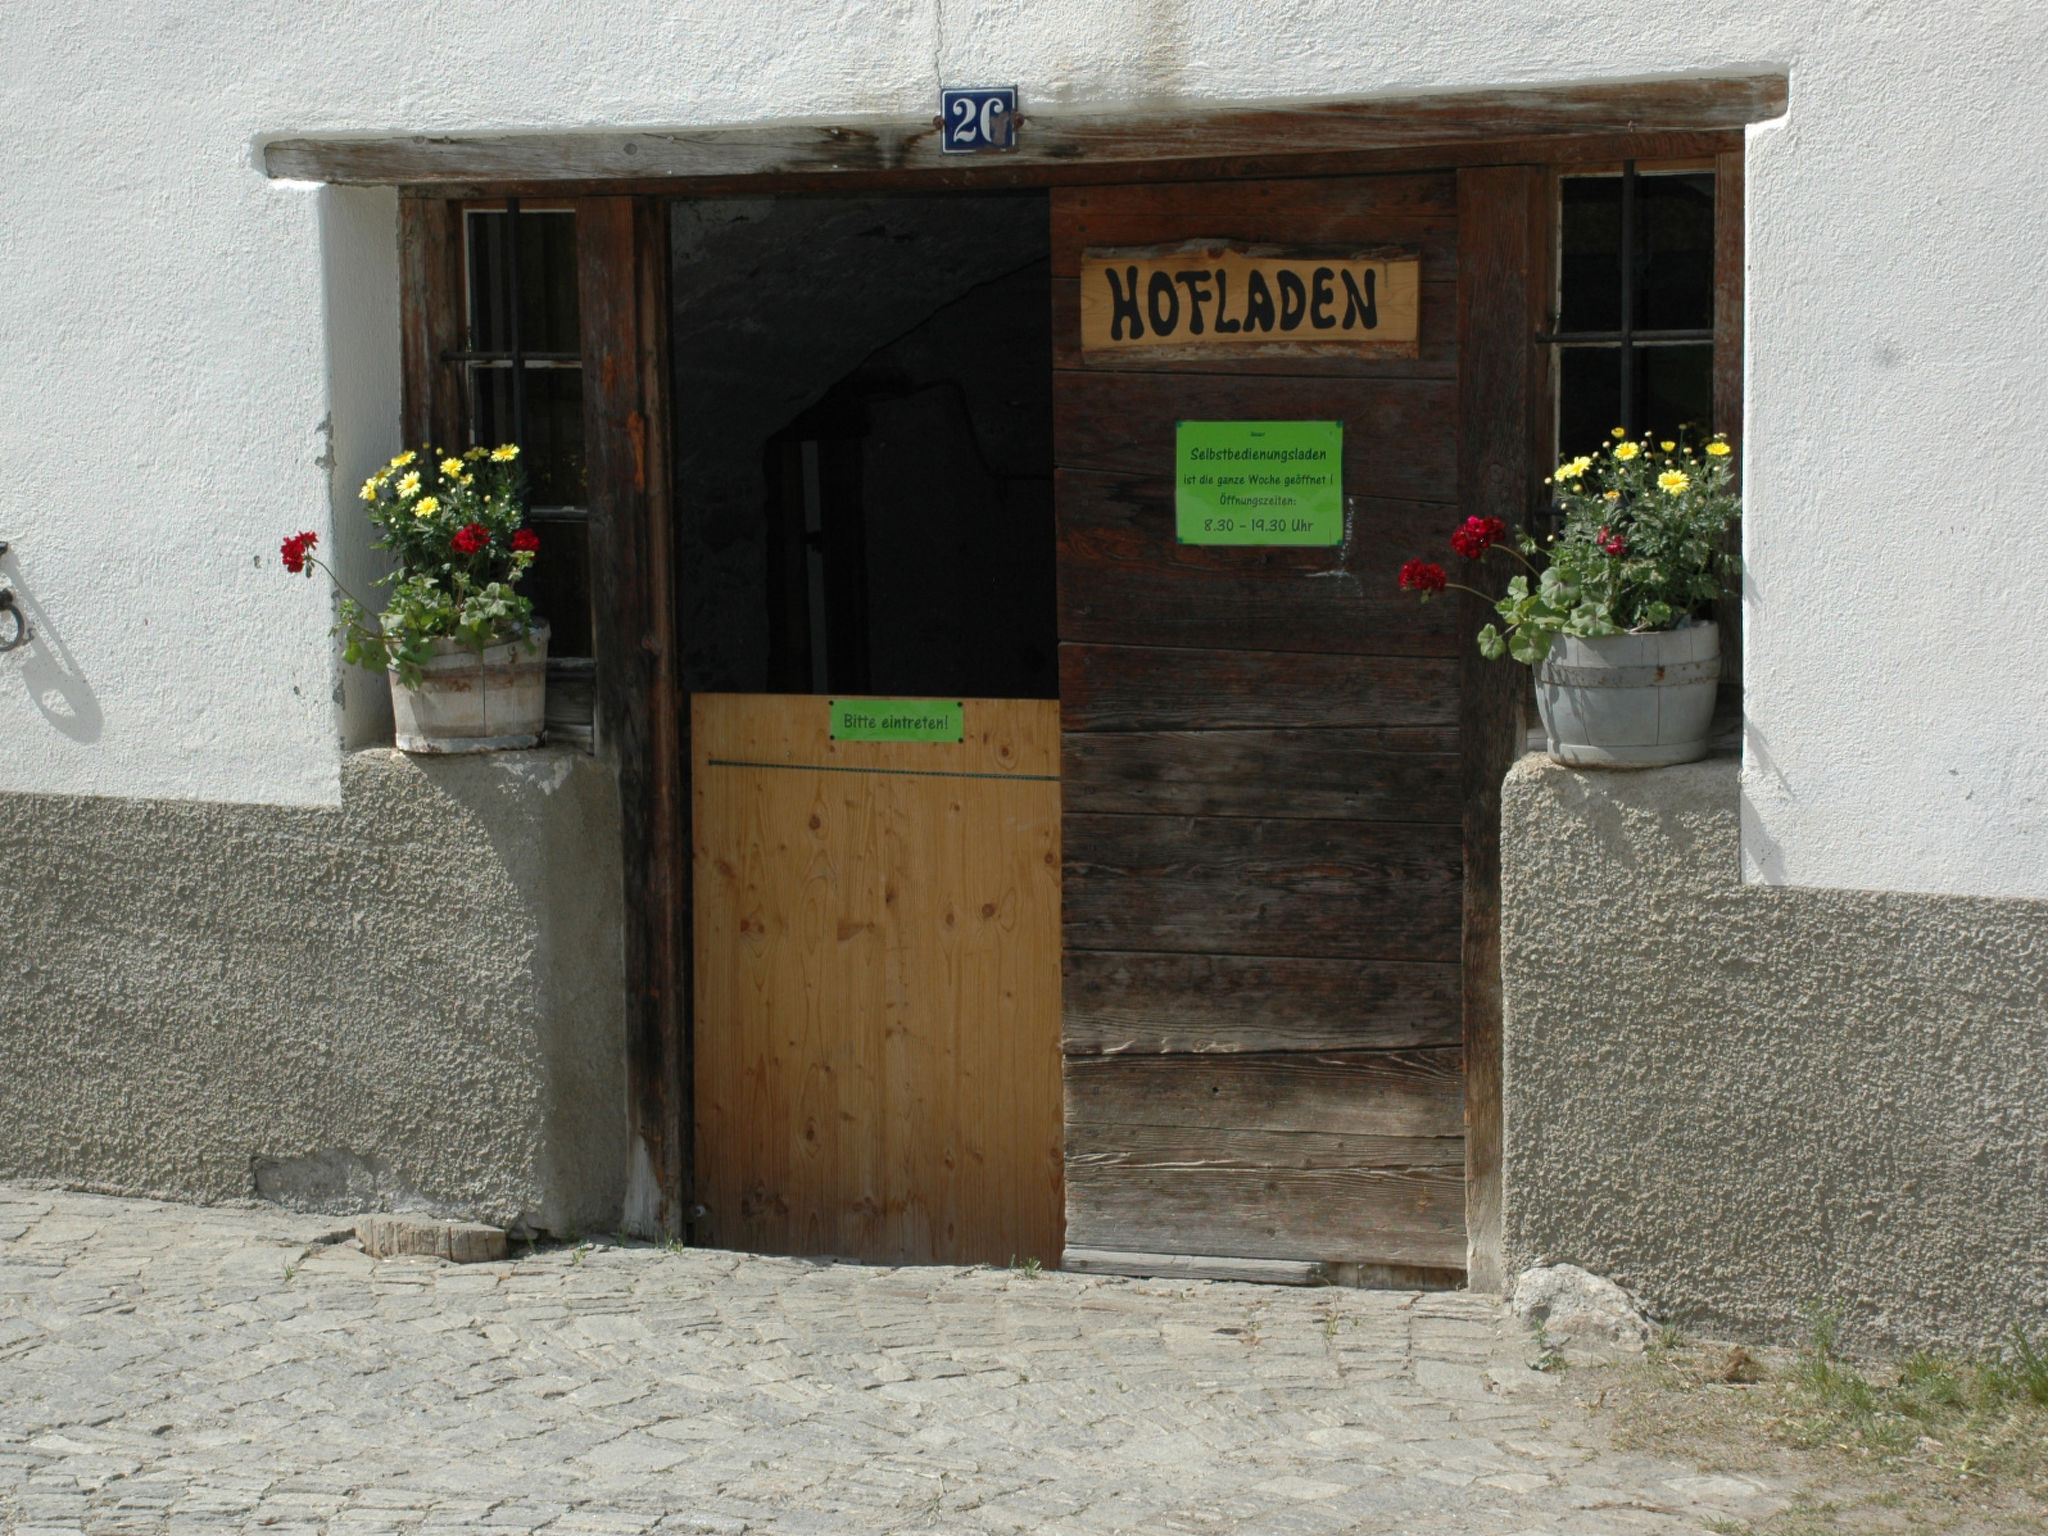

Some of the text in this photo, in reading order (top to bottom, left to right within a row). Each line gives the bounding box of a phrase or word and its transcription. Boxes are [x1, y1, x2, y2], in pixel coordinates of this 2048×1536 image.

[1106, 265, 1378, 341] HOFLADEN
[1190, 447, 1327, 463] Selbstbedienungsladen
[1183, 475, 1196, 485] ist
[1199, 475, 1214, 485] die
[1217, 476, 1246, 487] ganze
[1248, 474, 1281, 485] Woche
[1219, 492, 1297, 508] Öffnungszeiten:
[1203, 519, 1234, 532] 8.30
[1251, 519, 1287, 532] 19.30
[1291, 519, 1314, 532] Uhr
[843, 713, 949, 730] Bitte eintreten!
